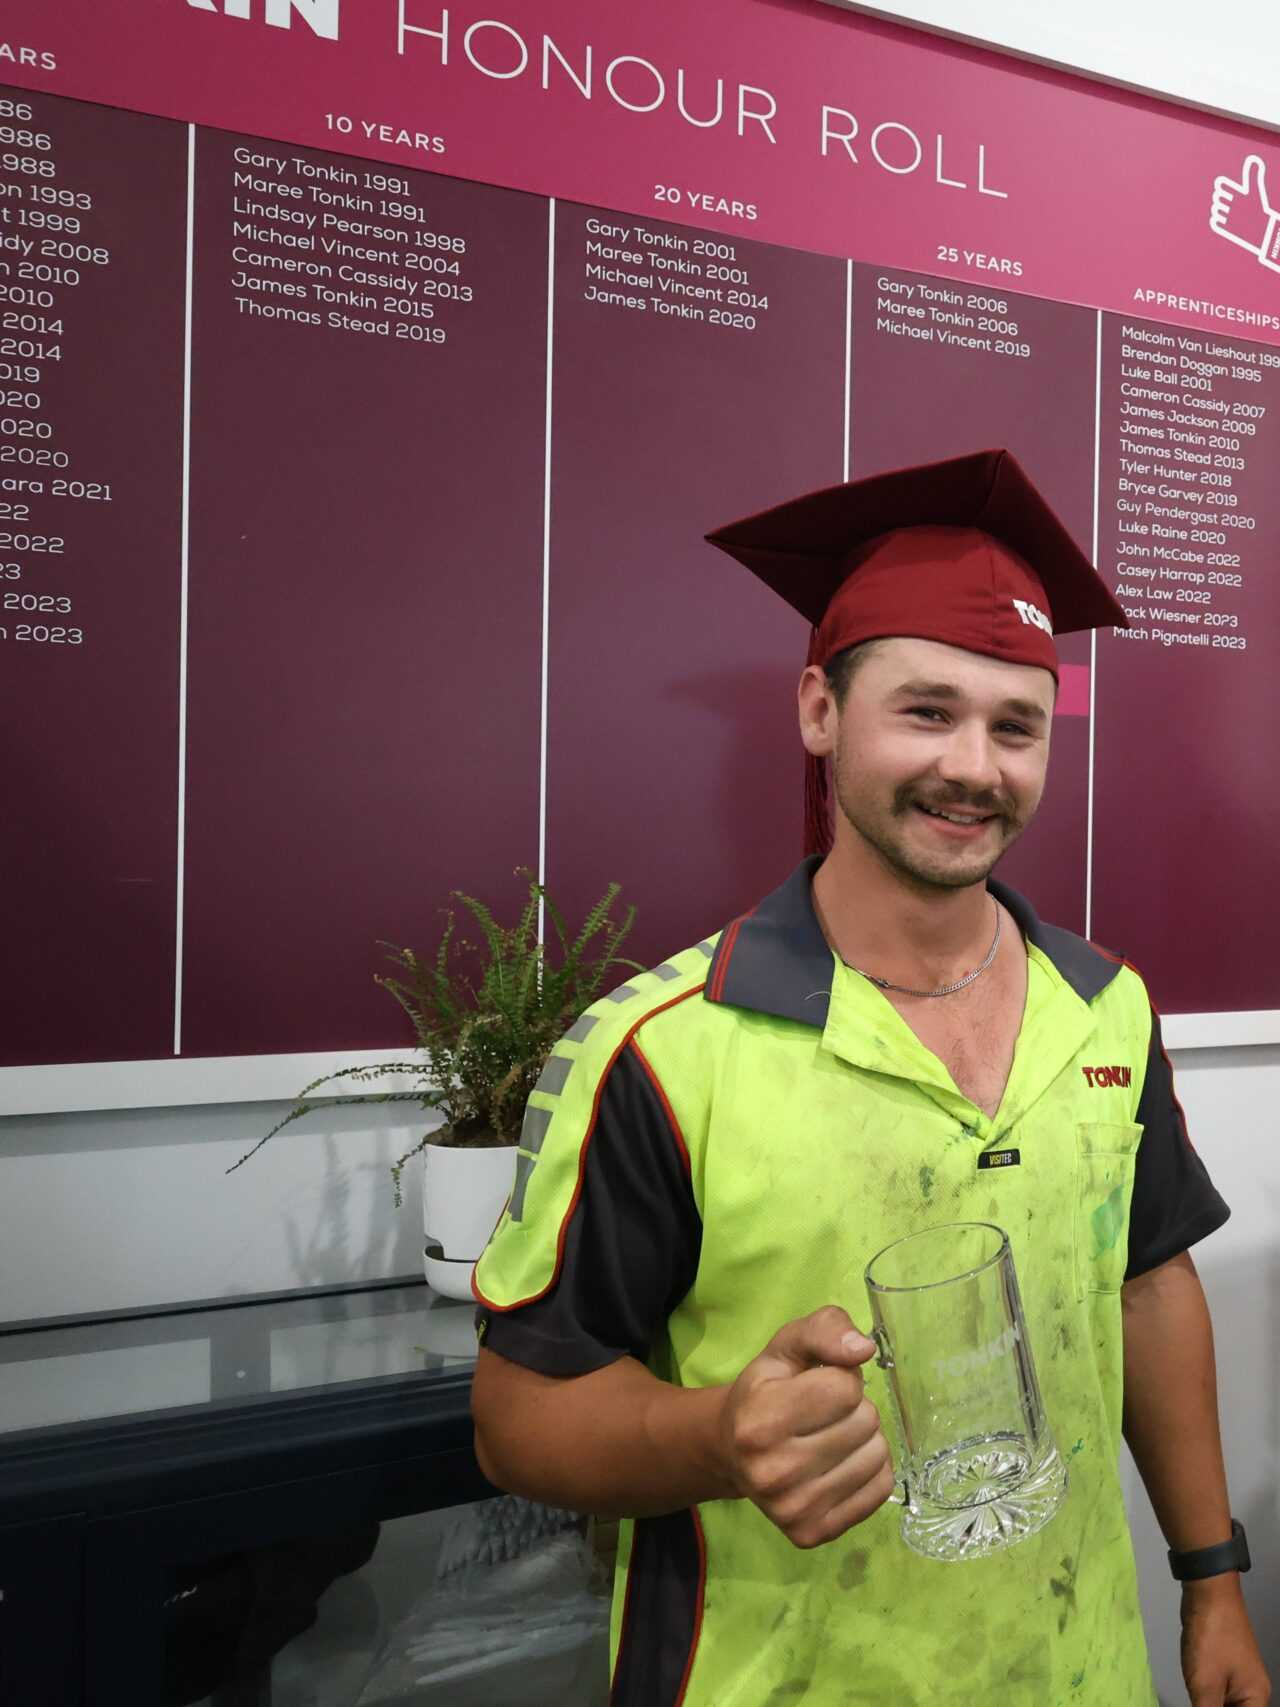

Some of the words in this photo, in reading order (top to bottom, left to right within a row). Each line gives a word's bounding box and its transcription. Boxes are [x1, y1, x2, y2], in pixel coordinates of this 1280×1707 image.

[397, 0, 777, 144] HONOUR
[820, 105, 1008, 198] ROLL
[325, 114, 352, 133] 10
[361, 121, 445, 153] YEARS
[0, 154, 55, 177] 988
[234, 147, 287, 175] Gary
[291, 158, 357, 185] Tonkin
[364, 173, 410, 196] 1991
[30, 185, 91, 210] 1993
[234, 172, 303, 199] Maree
[308, 186, 373, 213] Tonkin
[380, 200, 426, 223] 1991
[654, 185, 681, 203] 20
[687, 191, 757, 220] YEARS
[19, 209, 80, 234] 1999
[234, 196, 317, 229] Lindsay
[323, 213, 408, 243] Pearson
[415, 231, 465, 253] 1998
[41, 239, 109, 264] 2008
[233, 221, 314, 250] Michael
[321, 237, 399, 266] Vincent
[405, 253, 460, 276] 2004
[586, 219, 630, 243] Gary
[633, 227, 688, 251] Tonkin
[693, 240, 736, 261] 2001
[18, 262, 79, 286] 2010
[232, 247, 332, 277] Cameron
[338, 265, 418, 296] Cassidy
[424, 280, 473, 301] 2013
[586, 240, 643, 264] Maree
[647, 252, 701, 275] Tonkin
[706, 264, 749, 285] 2001
[937, 246, 959, 262] 25
[963, 251, 1023, 276] YEARS
[231, 272, 307, 298] James
[312, 284, 377, 309] Tonkin
[384, 297, 434, 318] 2015
[586, 263, 653, 288] Michael
[658, 276, 723, 302] Vincent
[727, 290, 768, 310] 2014
[877, 277, 914, 299] Gary
[917, 284, 963, 306] Tonkin
[967, 295, 1008, 314] 2006
[3, 312, 64, 335] 2014
[235, 297, 321, 325] Thomas
[328, 312, 389, 335] Stead
[396, 323, 446, 343] 2019
[584, 286, 646, 310] James
[650, 297, 704, 320] Tonkin
[709, 309, 756, 330] 2020
[878, 297, 925, 318] Maree
[928, 307, 974, 328] Tonkin
[978, 317, 1018, 336] 2006
[1134, 288, 1280, 330] APPRENTICESHIPS
[0, 338, 61, 361] 2014
[877, 318, 933, 340] Michael
[937, 329, 991, 351] Vincent
[995, 340, 1030, 357] 2019
[1122, 325, 1175, 347] Malcolm
[1177, 337, 1202, 352] Van
[1205, 342, 1256, 363] Lieshout
[1121, 363, 1151, 380] Luke
[1154, 370, 1177, 385] Ball
[1181, 374, 1212, 392] 2001
[1122, 344, 1177, 366] Brendan
[1180, 356, 1228, 377] Doggan
[1232, 366, 1262, 382] 1995
[1120, 382, 1180, 404] Cameron
[1182, 394, 1230, 415] Cassidy
[1233, 403, 1265, 418] 2007
[1, 418, 52, 439] 020
[1120, 401, 1165, 420] James
[1167, 410, 1219, 429] Jackson
[1222, 419, 1256, 436] 2009
[1120, 420, 1165, 439] James
[1167, 428, 1206, 445] Tonkin
[1209, 435, 1240, 451] 2010
[0, 446, 69, 468] 2020
[1120, 439, 1171, 458] Thomas
[1174, 448, 1211, 464] Stead
[1214, 454, 1245, 470] 2013
[1119, 458, 1151, 474] Tyler
[1154, 464, 1198, 481] Hunter
[1200, 472, 1232, 487] 2018
[2, 479, 43, 493] ara
[52, 480, 112, 500] 2021
[1119, 478, 1156, 495] Bryce
[1158, 484, 1204, 504] Garvey
[1206, 491, 1238, 507] 2019
[1117, 499, 1142, 516] Guy
[1145, 502, 1218, 525] Pendergast
[1221, 514, 1255, 530] 2020
[1119, 519, 1149, 535] Luke
[1152, 524, 1188, 540] Raine
[1190, 529, 1226, 545] 2020
[1116, 541, 1150, 557] John
[1153, 546, 1204, 563] McCabe
[1207, 552, 1240, 567] 2022
[1117, 562, 1157, 581] Casey
[1160, 567, 1205, 585] Harrap
[1208, 571, 1242, 587] 2022
[4, 593, 71, 613] 2023
[1115, 584, 1143, 597] Alex
[1147, 586, 1173, 600] Law
[1176, 589, 1211, 604] 2022
[1121, 604, 1146, 619] ack
[1149, 608, 1201, 624] Wiesner
[15, 624, 82, 644] 2023
[1113, 626, 1148, 640] Mitch
[1152, 629, 1209, 646] Pignatelli
[1212, 635, 1246, 649] 2023
[1081, 1066, 1131, 1088] TONKIN
